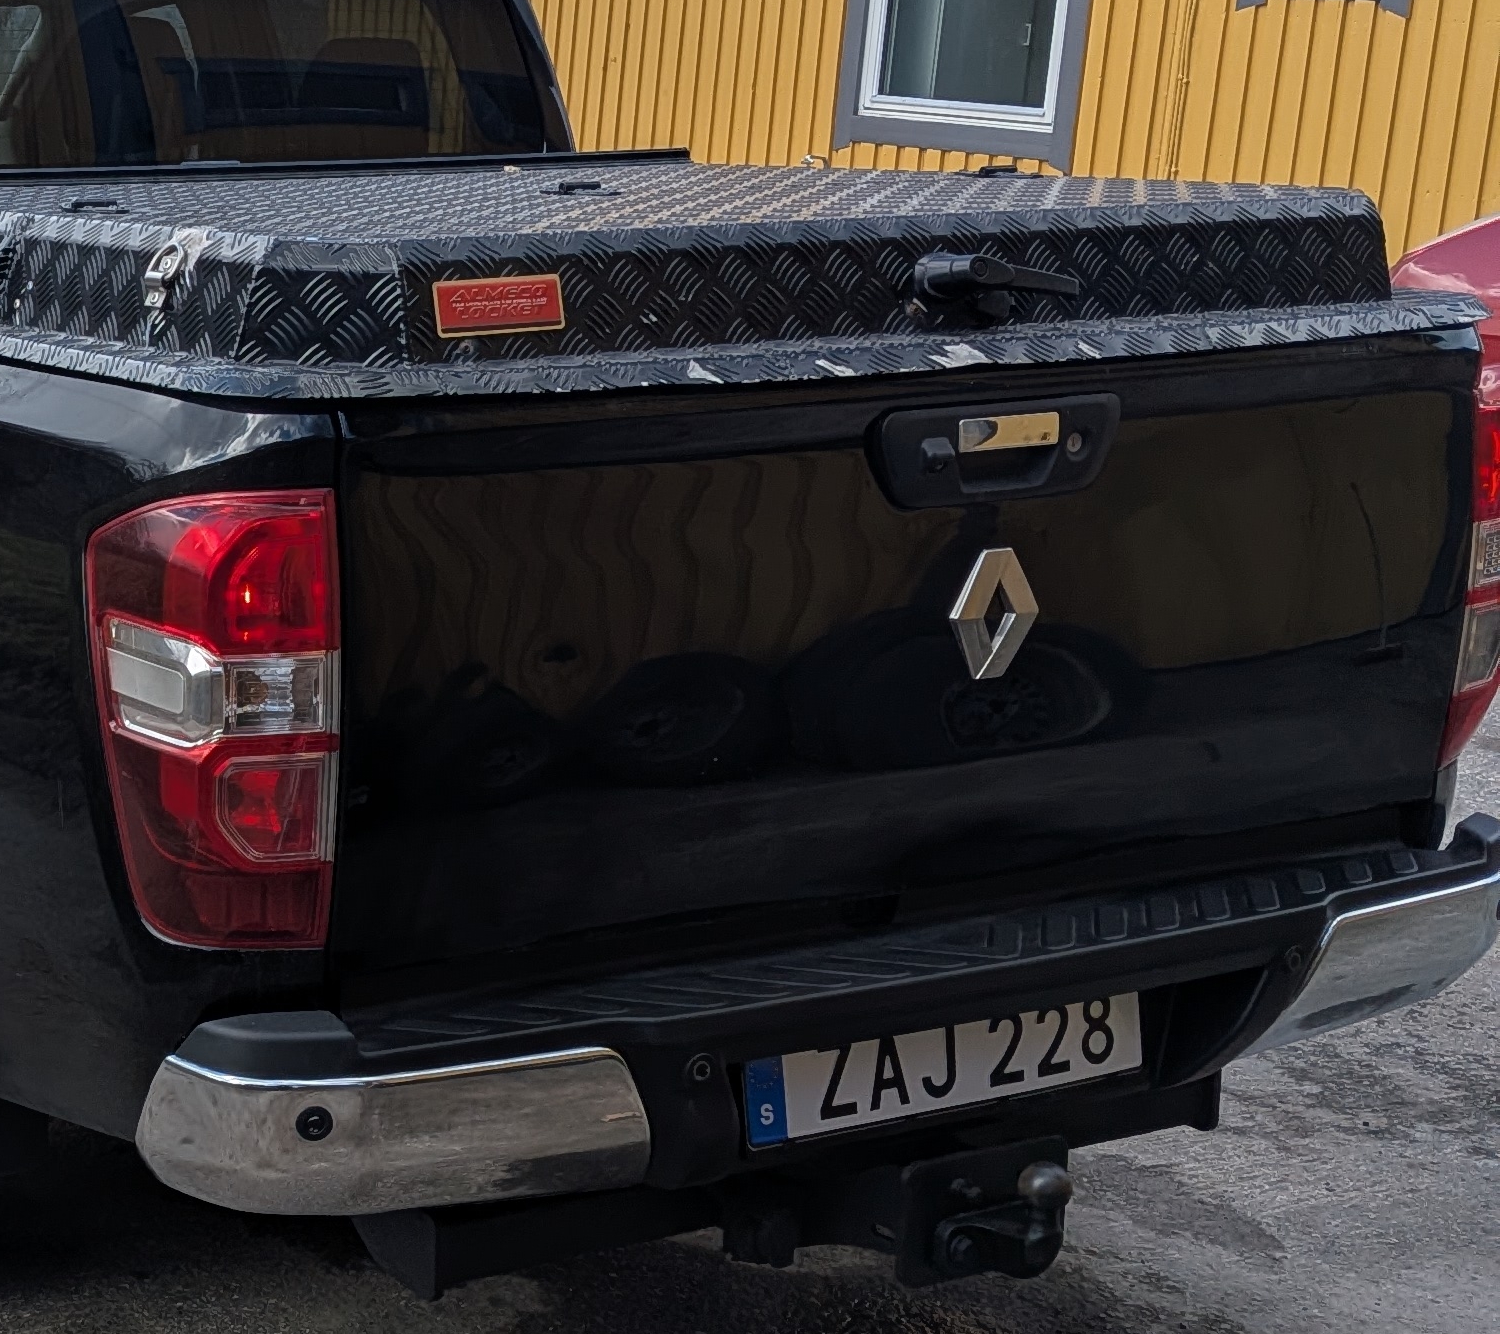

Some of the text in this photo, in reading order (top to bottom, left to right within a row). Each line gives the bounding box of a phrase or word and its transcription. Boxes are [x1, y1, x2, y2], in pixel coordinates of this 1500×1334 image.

[815, 998, 1115, 1121] ZAJ 228
[759, 1102, 775, 1126] S
